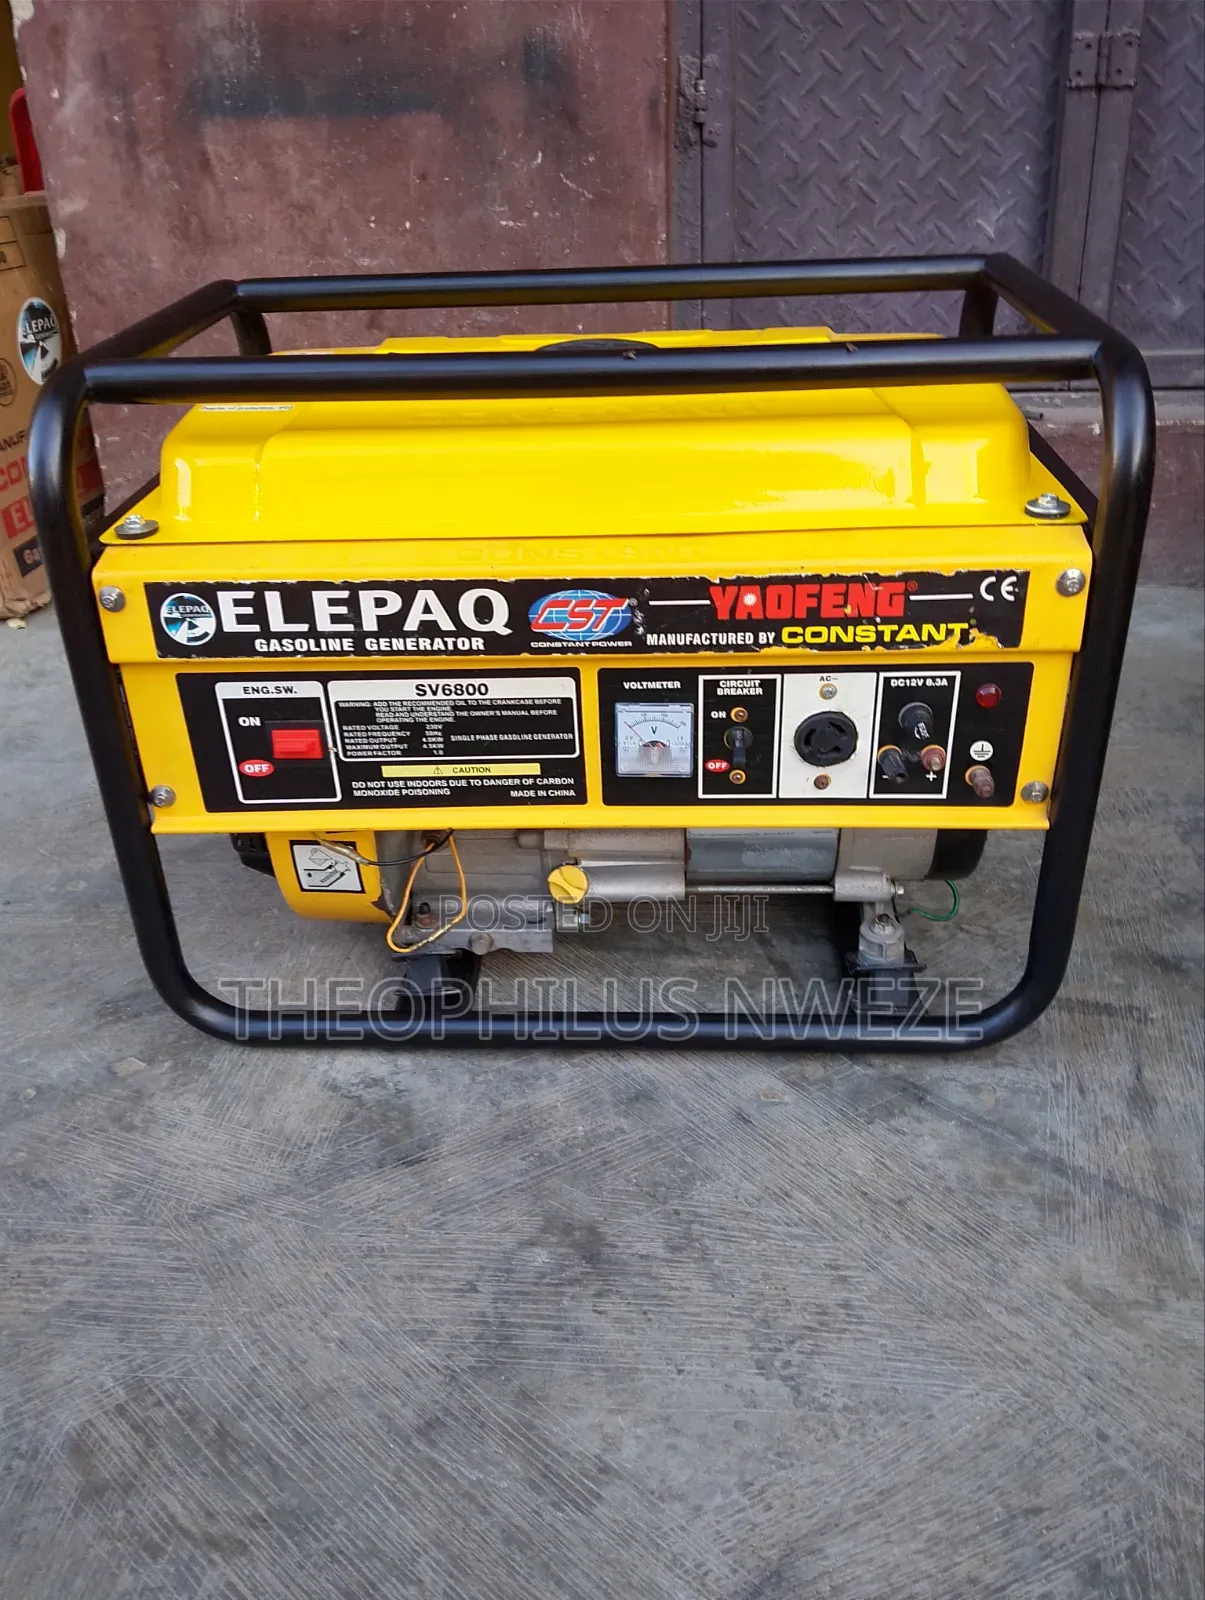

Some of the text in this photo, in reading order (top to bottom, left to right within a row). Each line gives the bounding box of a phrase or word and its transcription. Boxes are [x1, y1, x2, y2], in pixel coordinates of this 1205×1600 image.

[216, 588, 513, 635] ELEPAQ
[531, 598, 629, 632] CST
[781, 623, 969, 644] CONSTANT
[646, 632, 776, 646] MANUFACTURED BY
[255, 636, 485, 652] GASOLINE GENERATOR
[623, 681, 681, 690] VOLTMETER
[719, 680, 761, 688] CIRCUIT
[890, 678, 948, 687] DC12V 8.3A
[415, 683, 489, 697] SV6800
[716, 687, 763, 695] BREAKER
[238, 716, 261, 727] ON
[650, 726, 658, 735] V
[244, 764, 269, 773] OFF
[536, 777, 574, 785] CARBON
[401, 788, 451, 796] POISONING
[548, 789, 576, 797] CHINA
